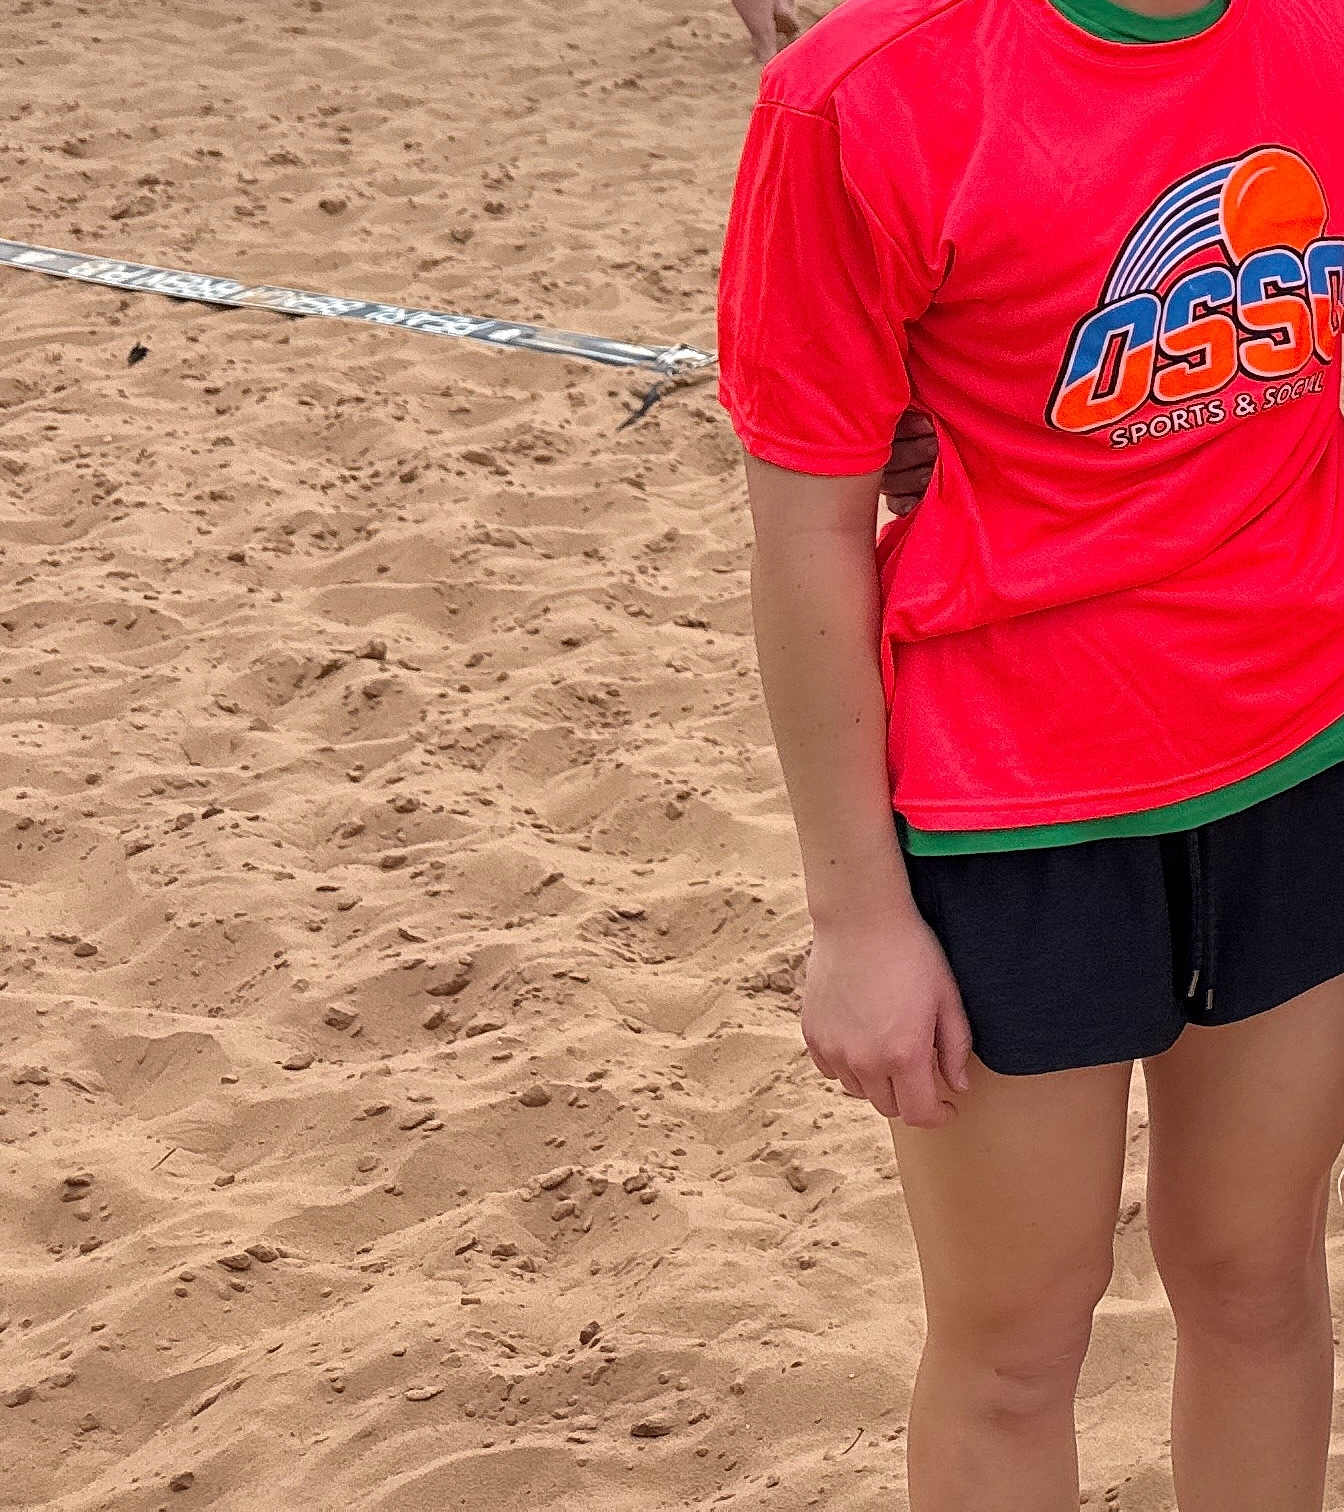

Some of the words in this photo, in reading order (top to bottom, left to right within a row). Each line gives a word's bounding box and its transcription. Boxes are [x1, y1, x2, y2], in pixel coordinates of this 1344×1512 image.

[1111, 402, 1225, 449] SPORTS
[1235, 393, 1258, 417] &
[1263, 371, 1325, 410] SOCIAL
